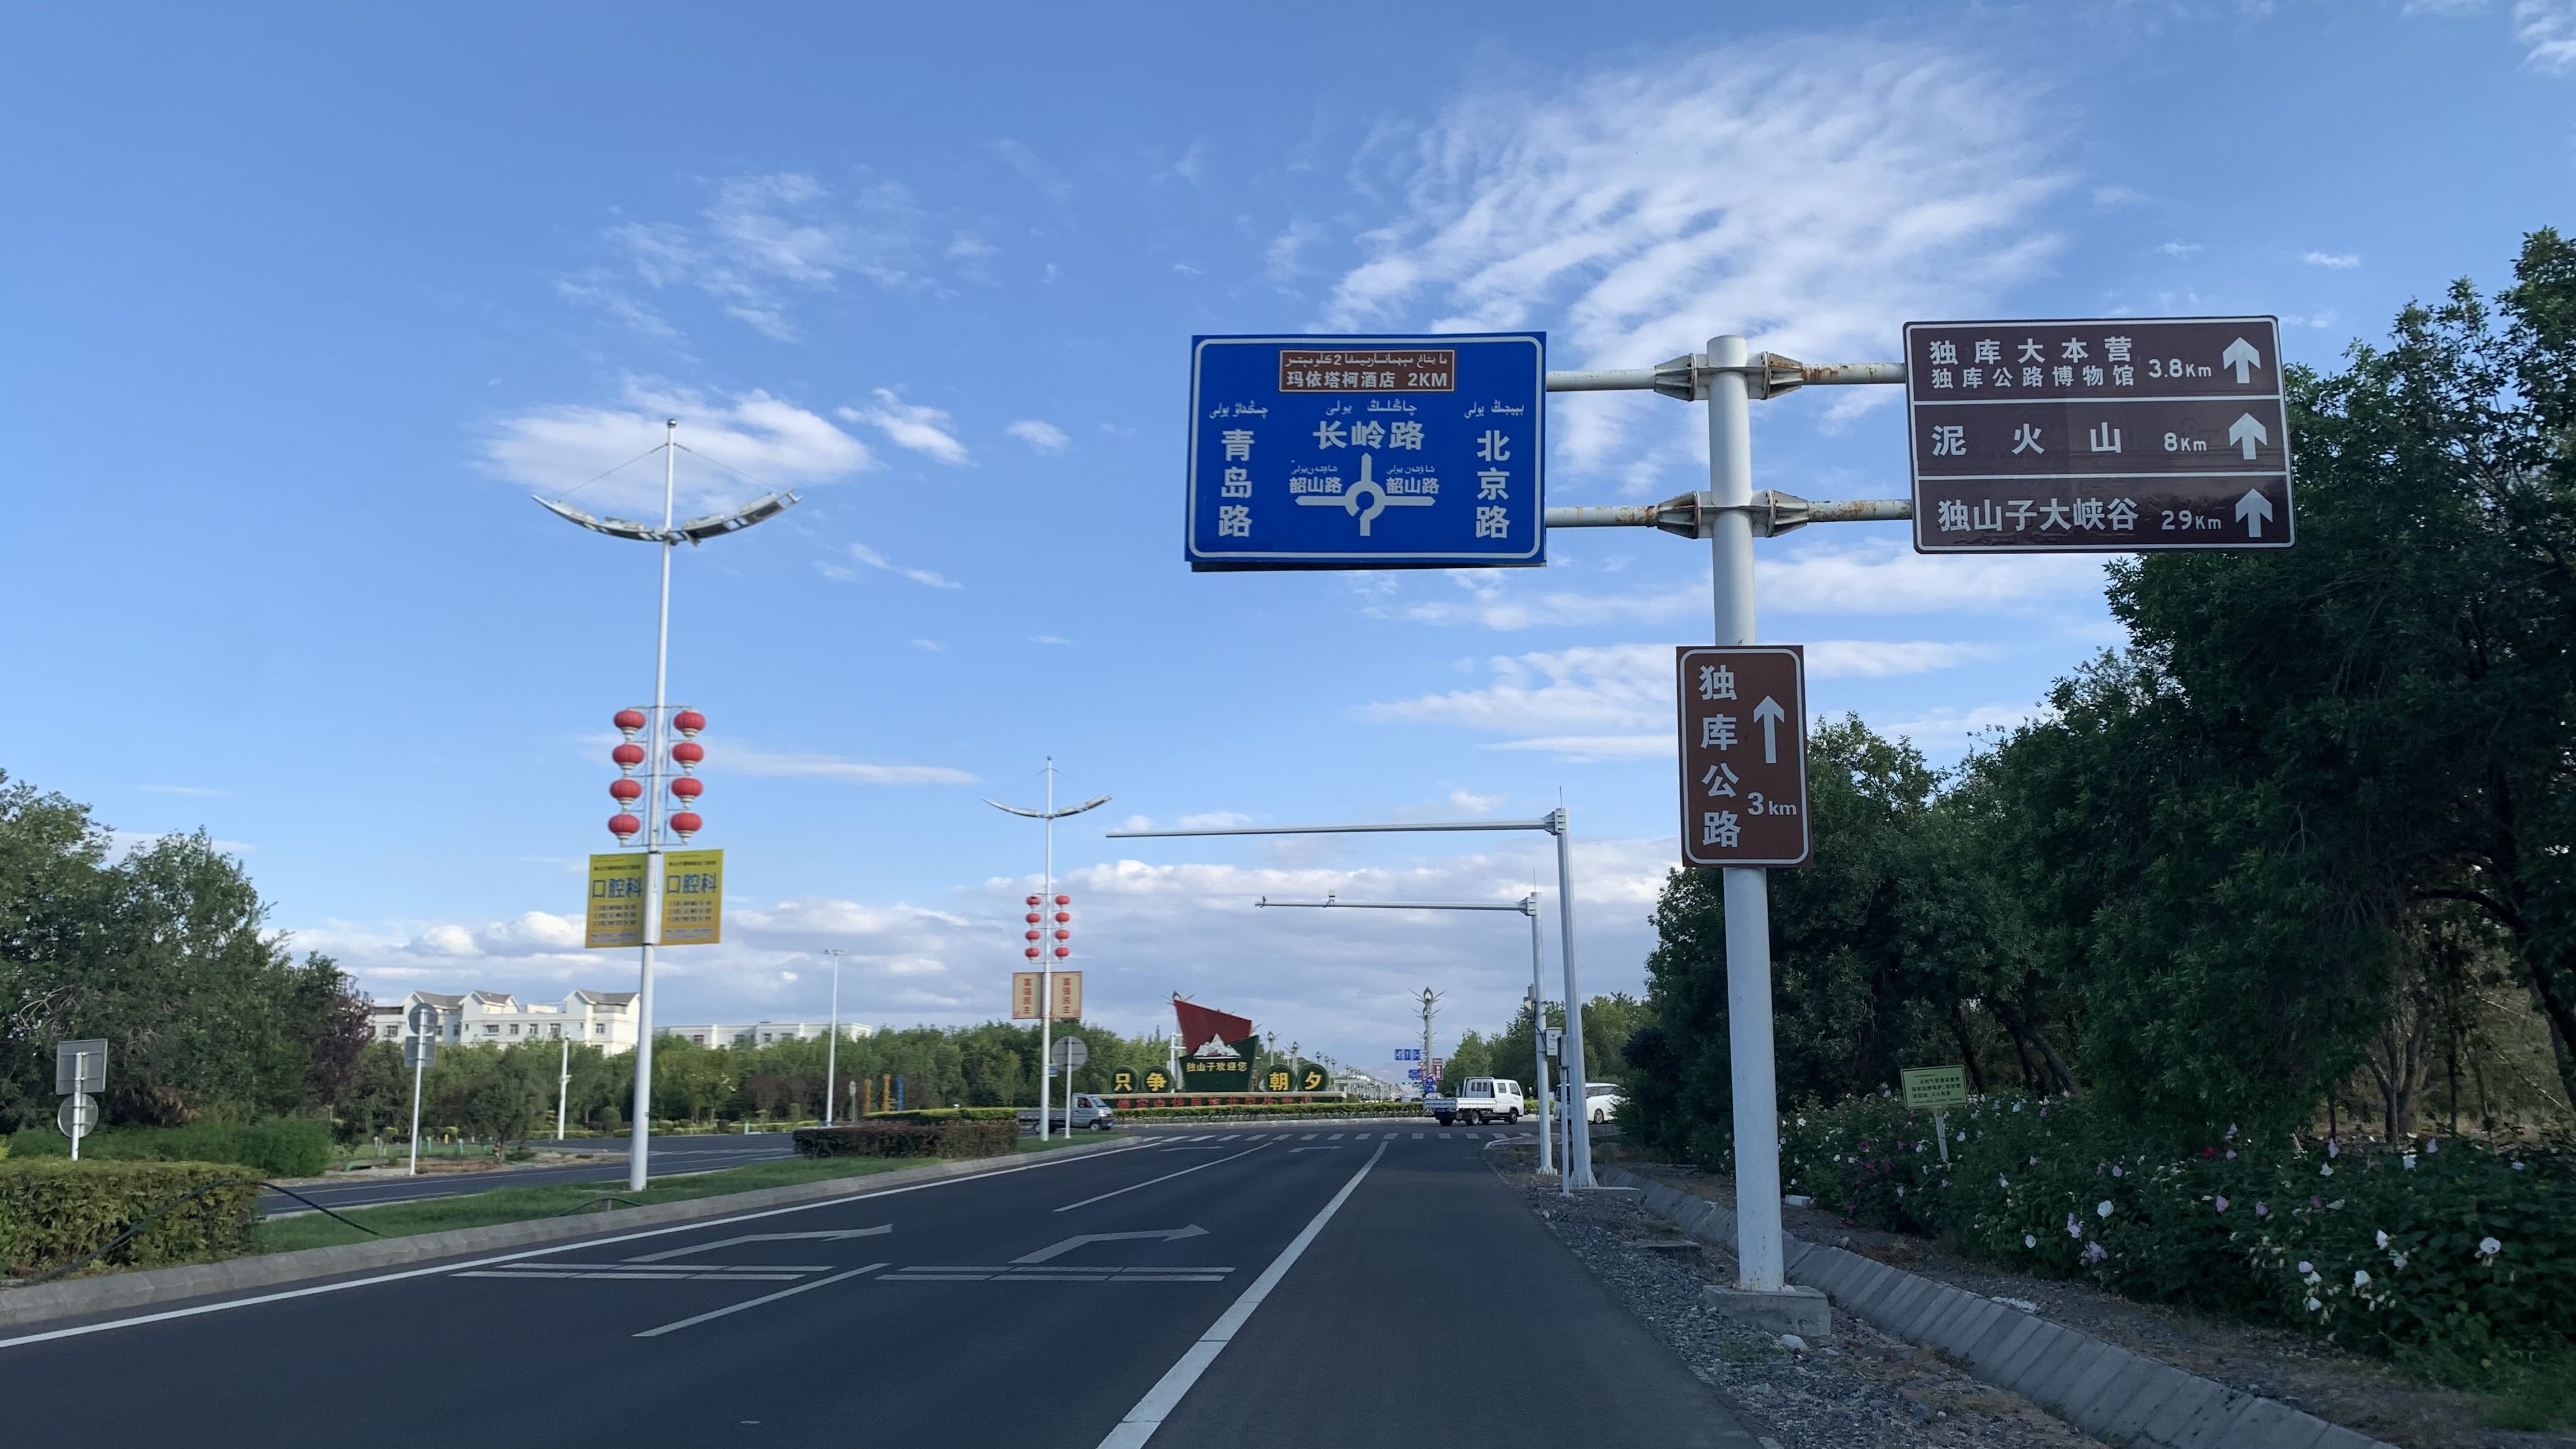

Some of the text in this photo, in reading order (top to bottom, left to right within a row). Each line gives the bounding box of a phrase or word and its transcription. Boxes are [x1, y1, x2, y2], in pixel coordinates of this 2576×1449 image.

[1930, 337, 2132, 365] 独库大本营
[1287, 371, 1448, 388] 玛依塔柯酒店 2KM
[1932, 359, 2211, 389] 独库公路博物馆 3.8Km
[1313, 420, 1424, 450] 长岭路
[1932, 422, 2206, 456] 泥火山 8Km
[1218, 429, 1255, 537] 青岛路
[1289, 477, 1342, 493] 韶山路
[1386, 477, 1439, 494] 韶山路
[1476, 430, 1510, 538] 北京路
[1938, 498, 2221, 532] 独山子大峡谷 29Km
[1699, 665, 1741, 847] 独库公路
[593, 877, 643, 898] 口腔科
[667, 873, 718, 894] 口腔科
[1186, 1061, 1248, 1073] 独山子欢迎您
[1114, 1073, 1167, 1092] 只争
[1268, 1071, 1322, 1091] 朝夕
